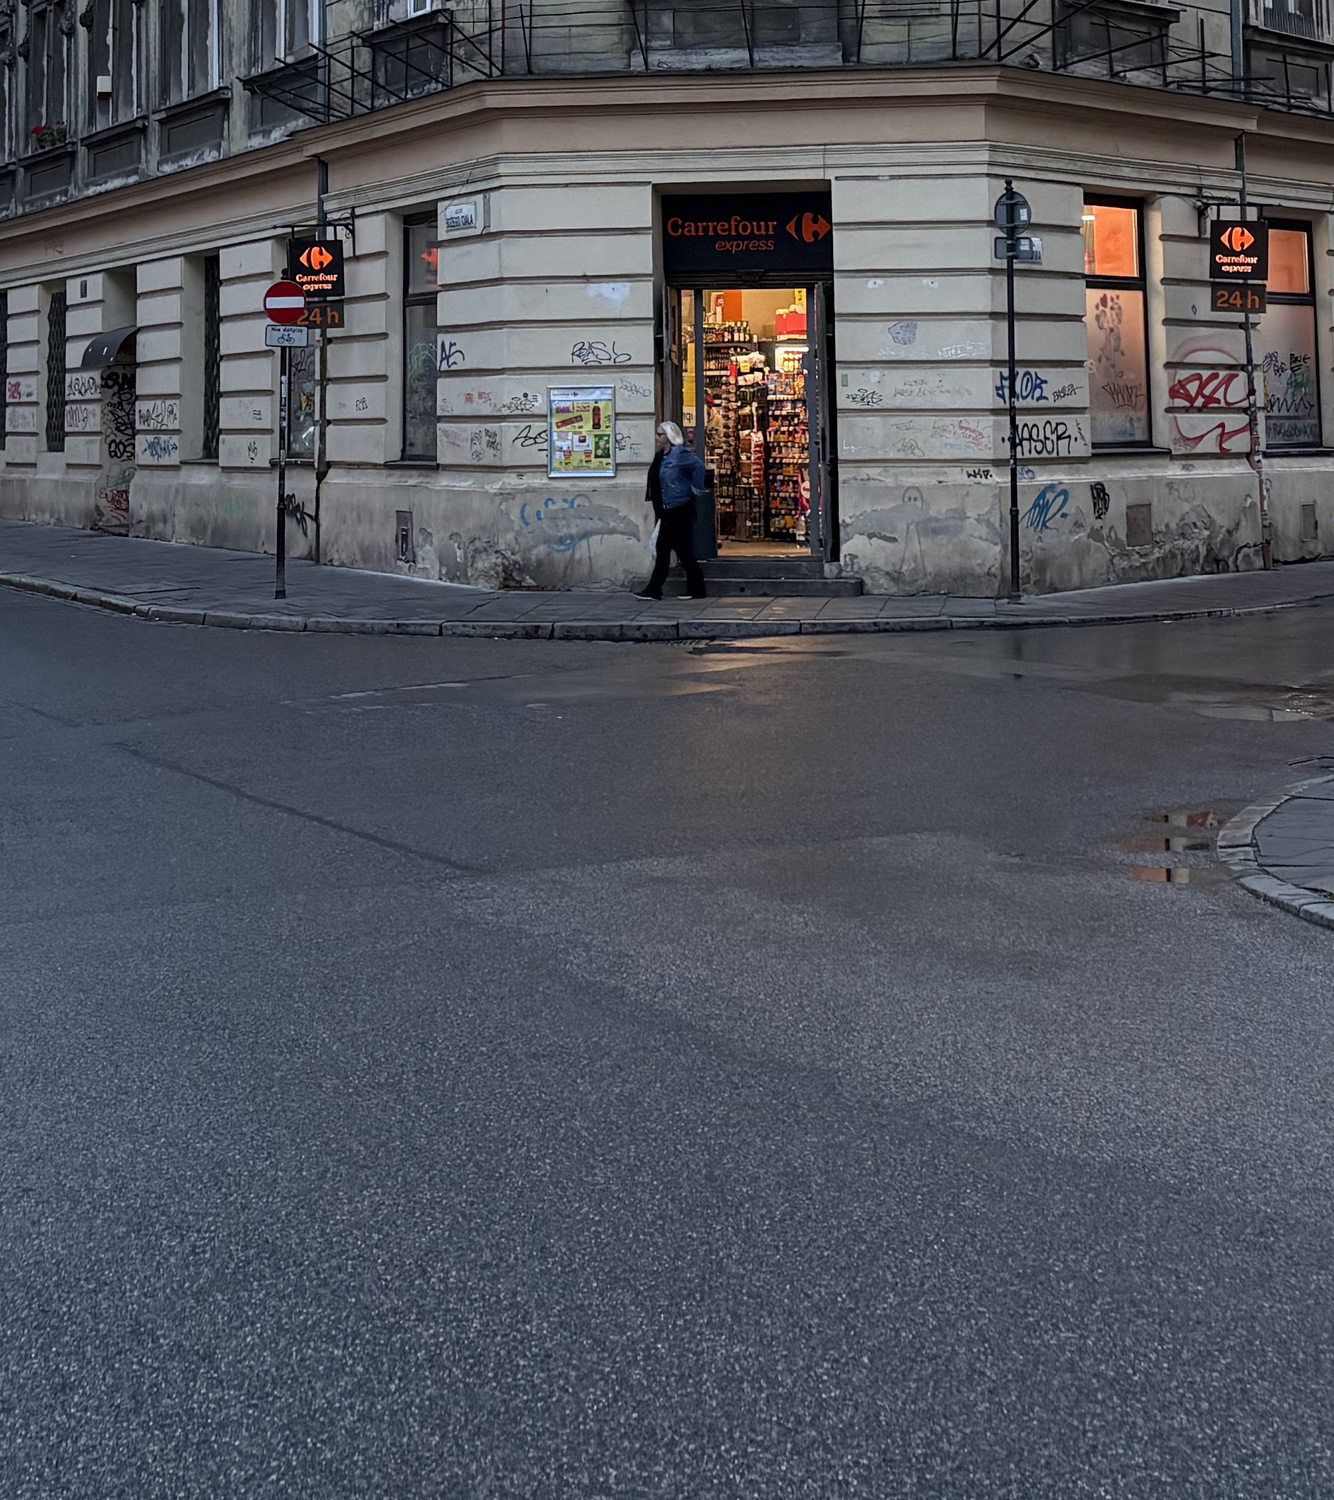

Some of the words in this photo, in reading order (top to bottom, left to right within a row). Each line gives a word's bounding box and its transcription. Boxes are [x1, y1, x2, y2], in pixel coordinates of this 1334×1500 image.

[667, 215, 777, 237] Carrefour
[715, 240, 775, 254] express
[1215, 254, 1259, 264] Carrefour
[1221, 265, 1252, 273] express
[295, 272, 338, 282] Carrefour
[303, 283, 332, 291] express
[1216, 289, 1243, 309] 24
[1247, 289, 1260, 310] h
[296, 307, 323, 326] 24
[327, 306, 340, 325] h
